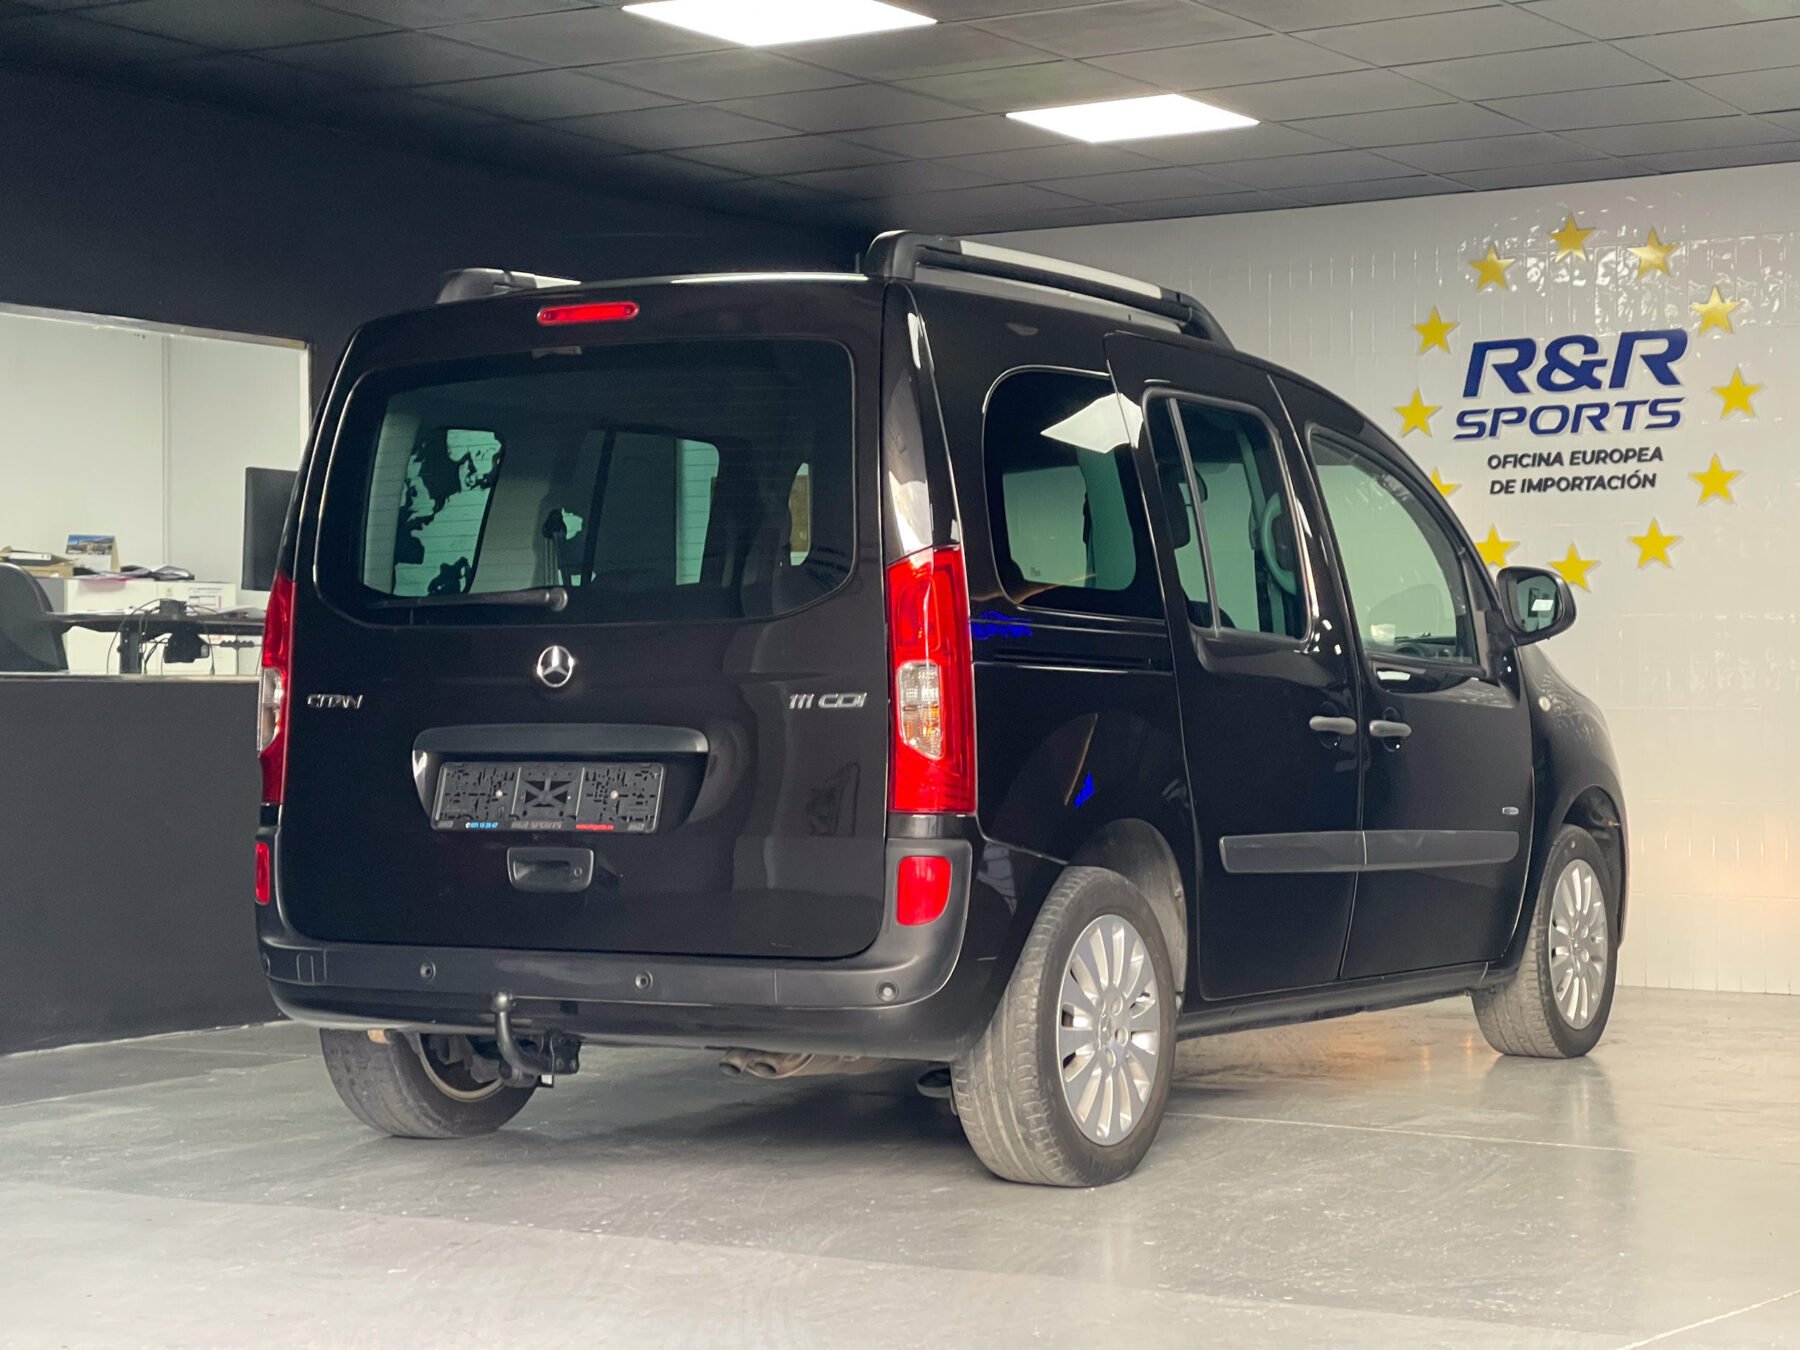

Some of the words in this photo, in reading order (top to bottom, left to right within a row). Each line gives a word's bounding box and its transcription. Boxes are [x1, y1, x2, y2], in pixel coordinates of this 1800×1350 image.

[1463, 328, 1689, 398] R&R
[1453, 397, 1685, 440] SPORTS
[1487, 451, 1564, 470] OFICINA
[1569, 446, 1664, 466] EUROPEA
[1489, 480, 1516, 495] DE
[1520, 470, 1657, 493] IMPORTACIÓN
